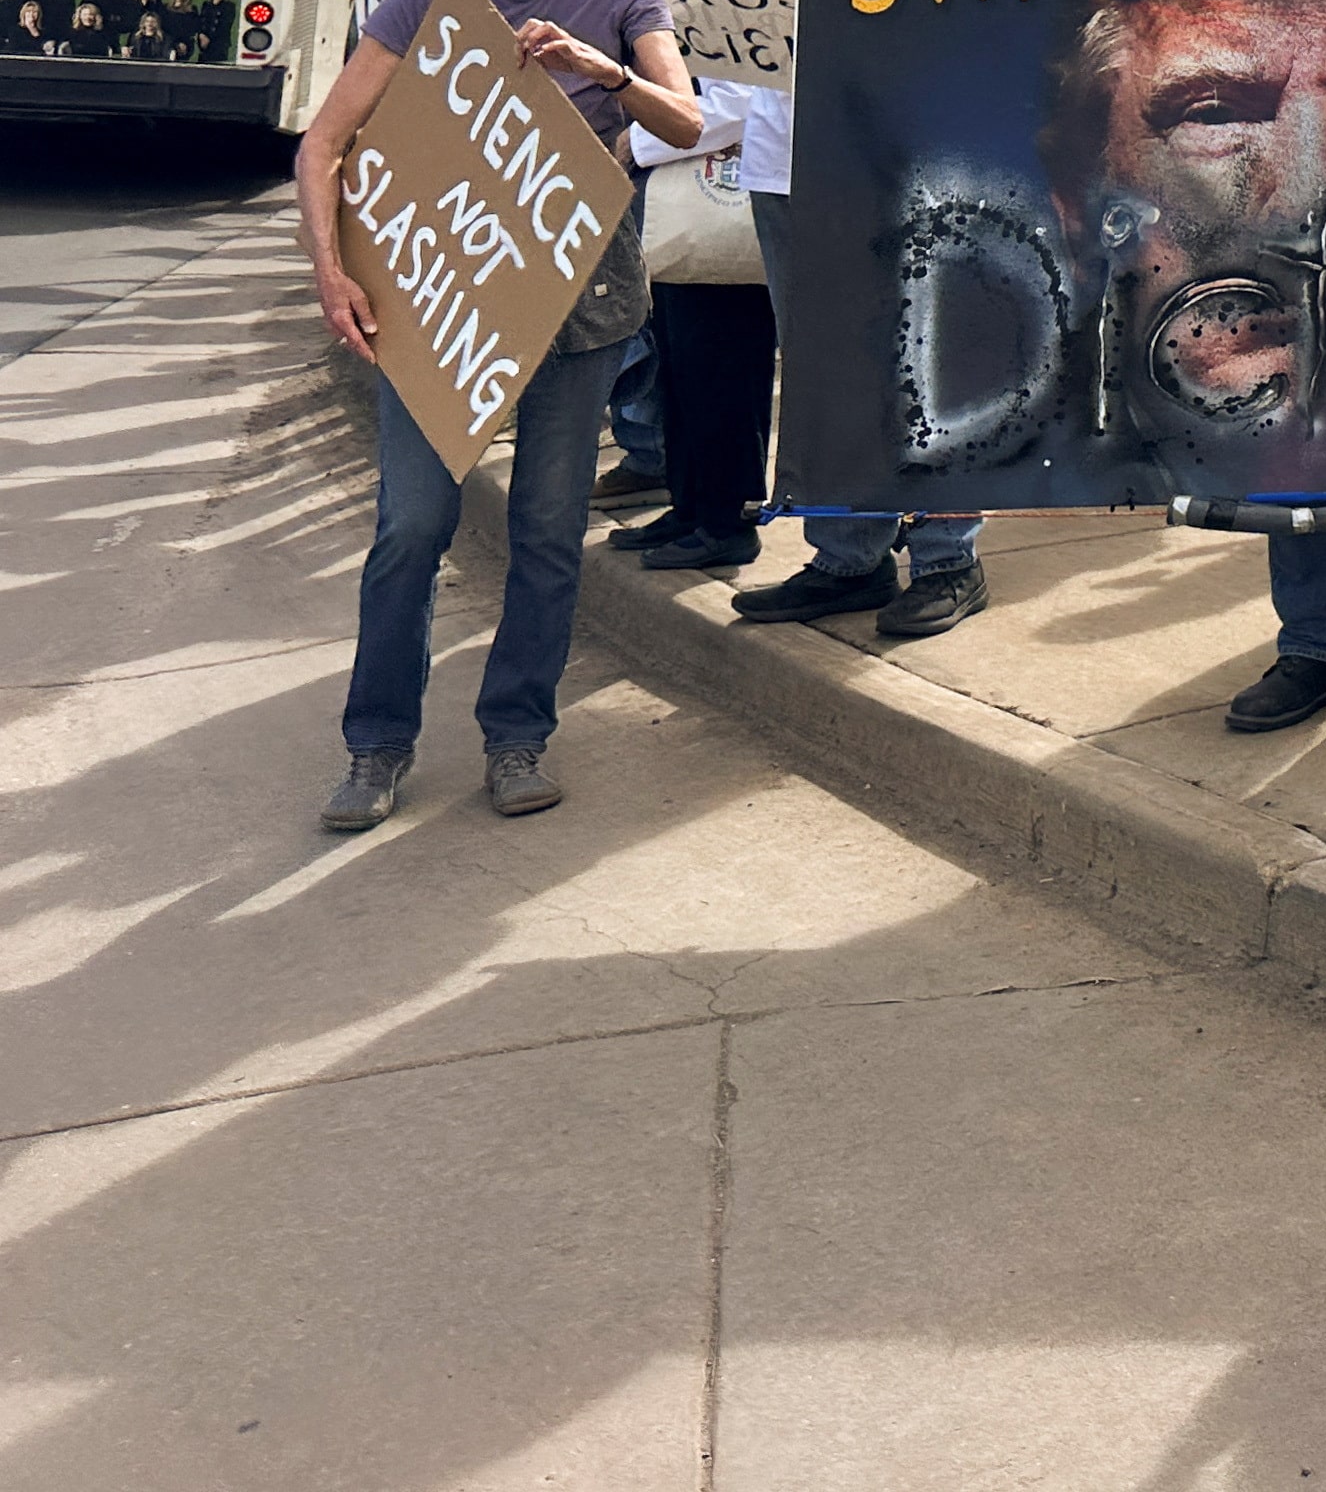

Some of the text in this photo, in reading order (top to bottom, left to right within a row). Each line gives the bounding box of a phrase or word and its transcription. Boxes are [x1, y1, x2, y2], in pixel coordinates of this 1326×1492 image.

[418, 14, 603, 281] SCIENCE
[437, 180, 525, 286] NOT
[342, 148, 521, 436] SLASHING
